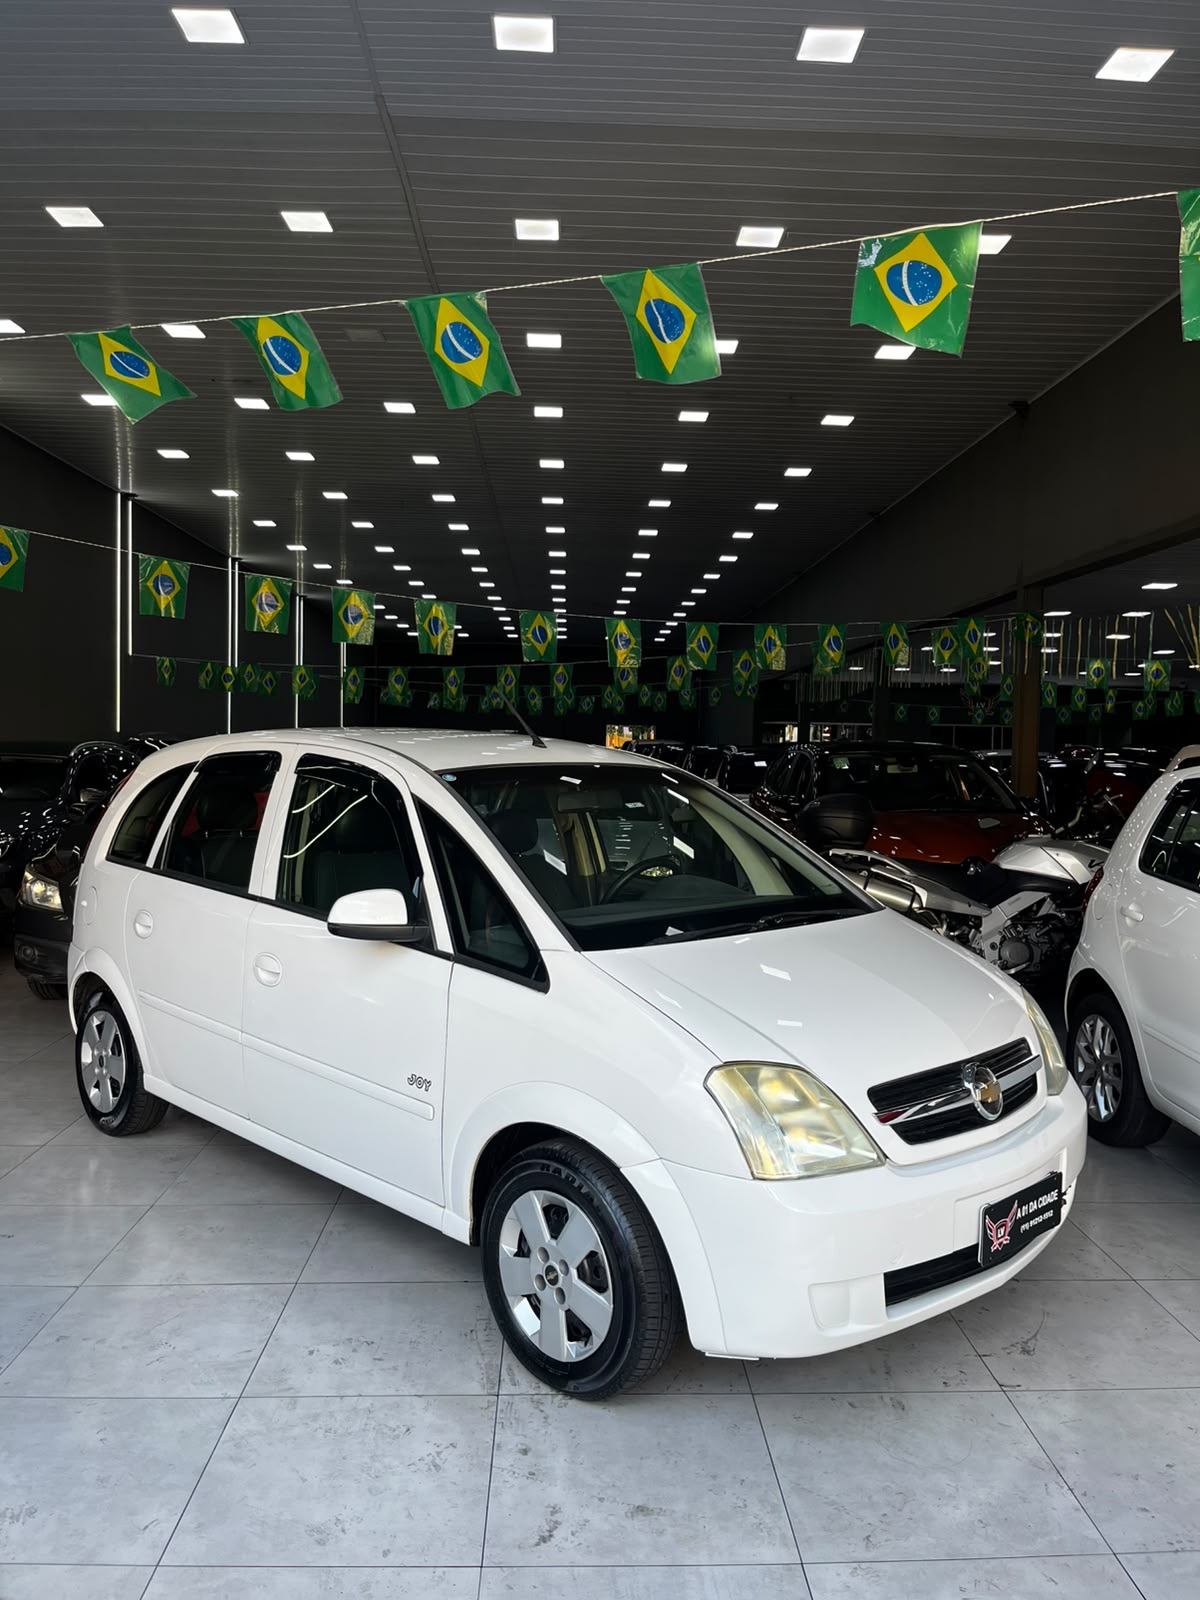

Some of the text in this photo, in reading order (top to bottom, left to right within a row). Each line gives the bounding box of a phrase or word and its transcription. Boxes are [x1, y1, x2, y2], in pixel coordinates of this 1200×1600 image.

[407, 1073, 432, 1092] JOY
[1016, 1207, 1022, 1220] A
[1029, 1199, 1038, 1213] DA
[1037, 1188, 1059, 1209] CIDADE
